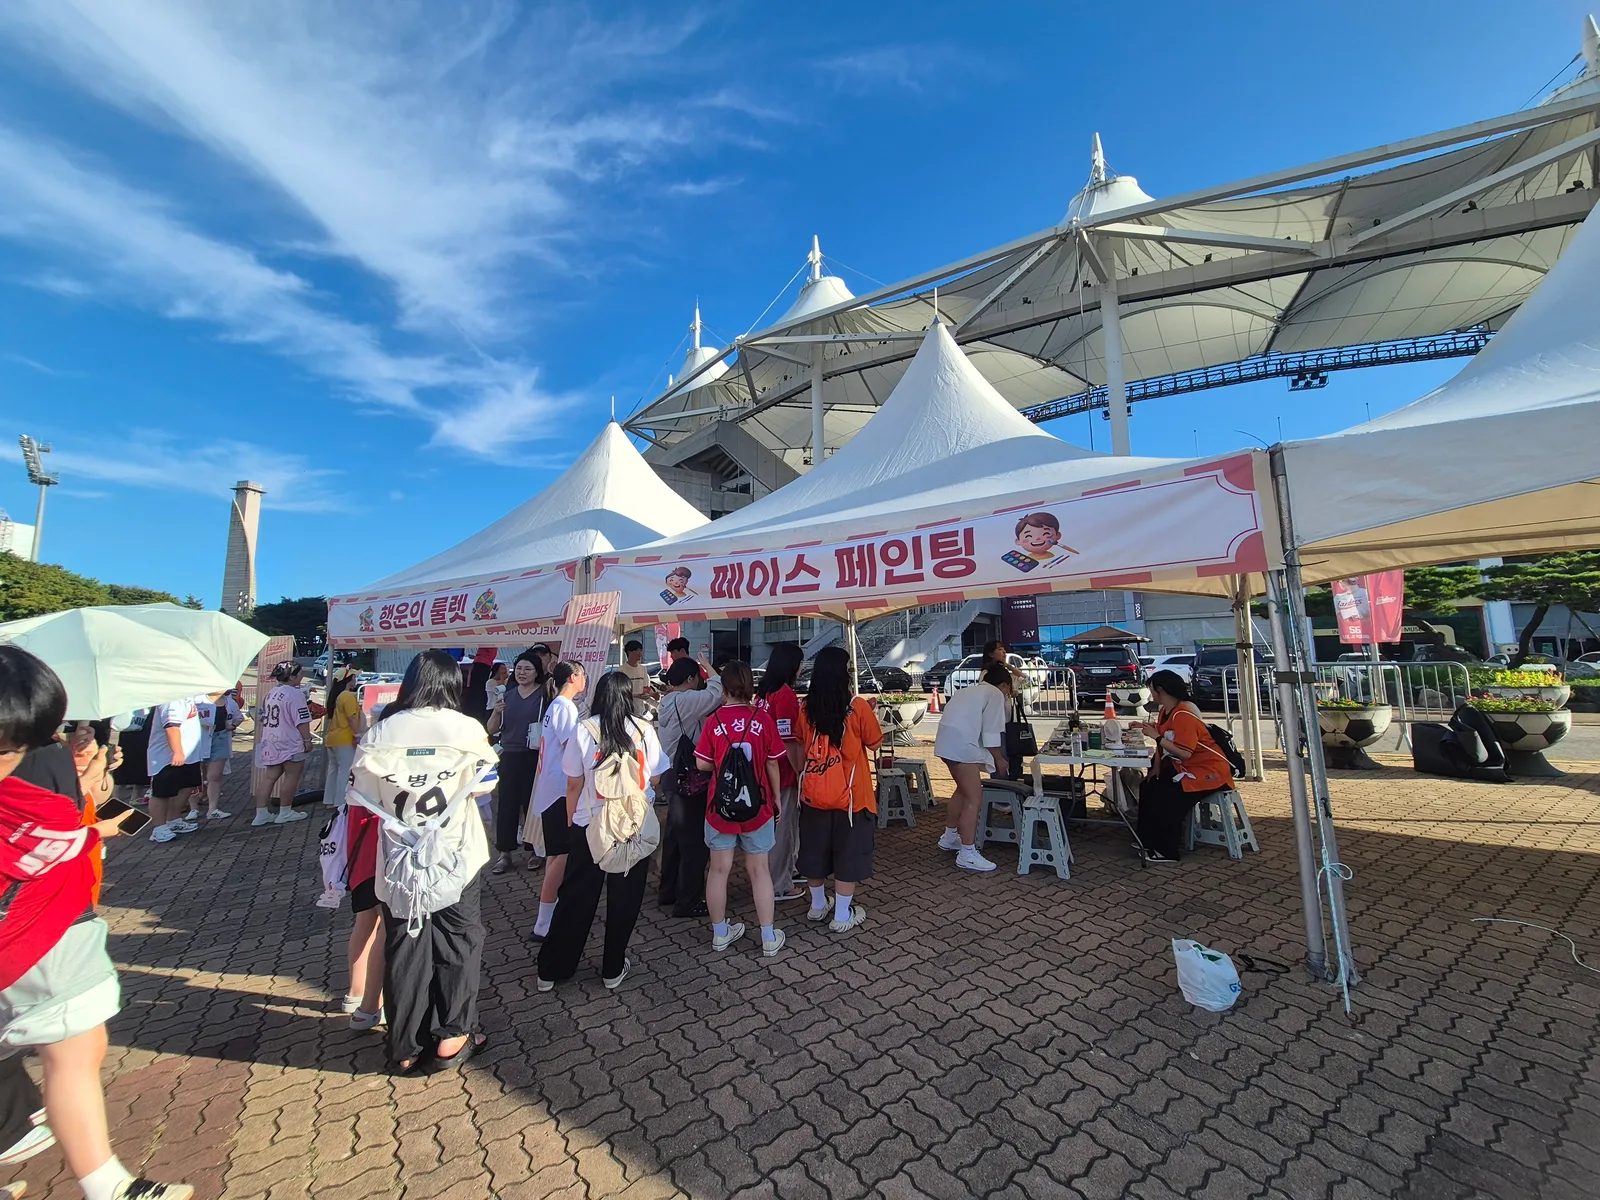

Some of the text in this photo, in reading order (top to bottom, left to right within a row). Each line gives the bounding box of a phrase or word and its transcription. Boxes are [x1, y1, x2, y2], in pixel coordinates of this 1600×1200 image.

[710, 527, 977, 599] 페이스 페인팅
[379, 593, 469, 630] 행운의 룰렛
[576, 602, 609, 624] Landers
[1348, 626, 1362, 634] 56
[576, 637, 597, 649] 랜더스
[562, 651, 606, 663] 페이스 페인팅
[805, 755, 840, 775] Eagles
